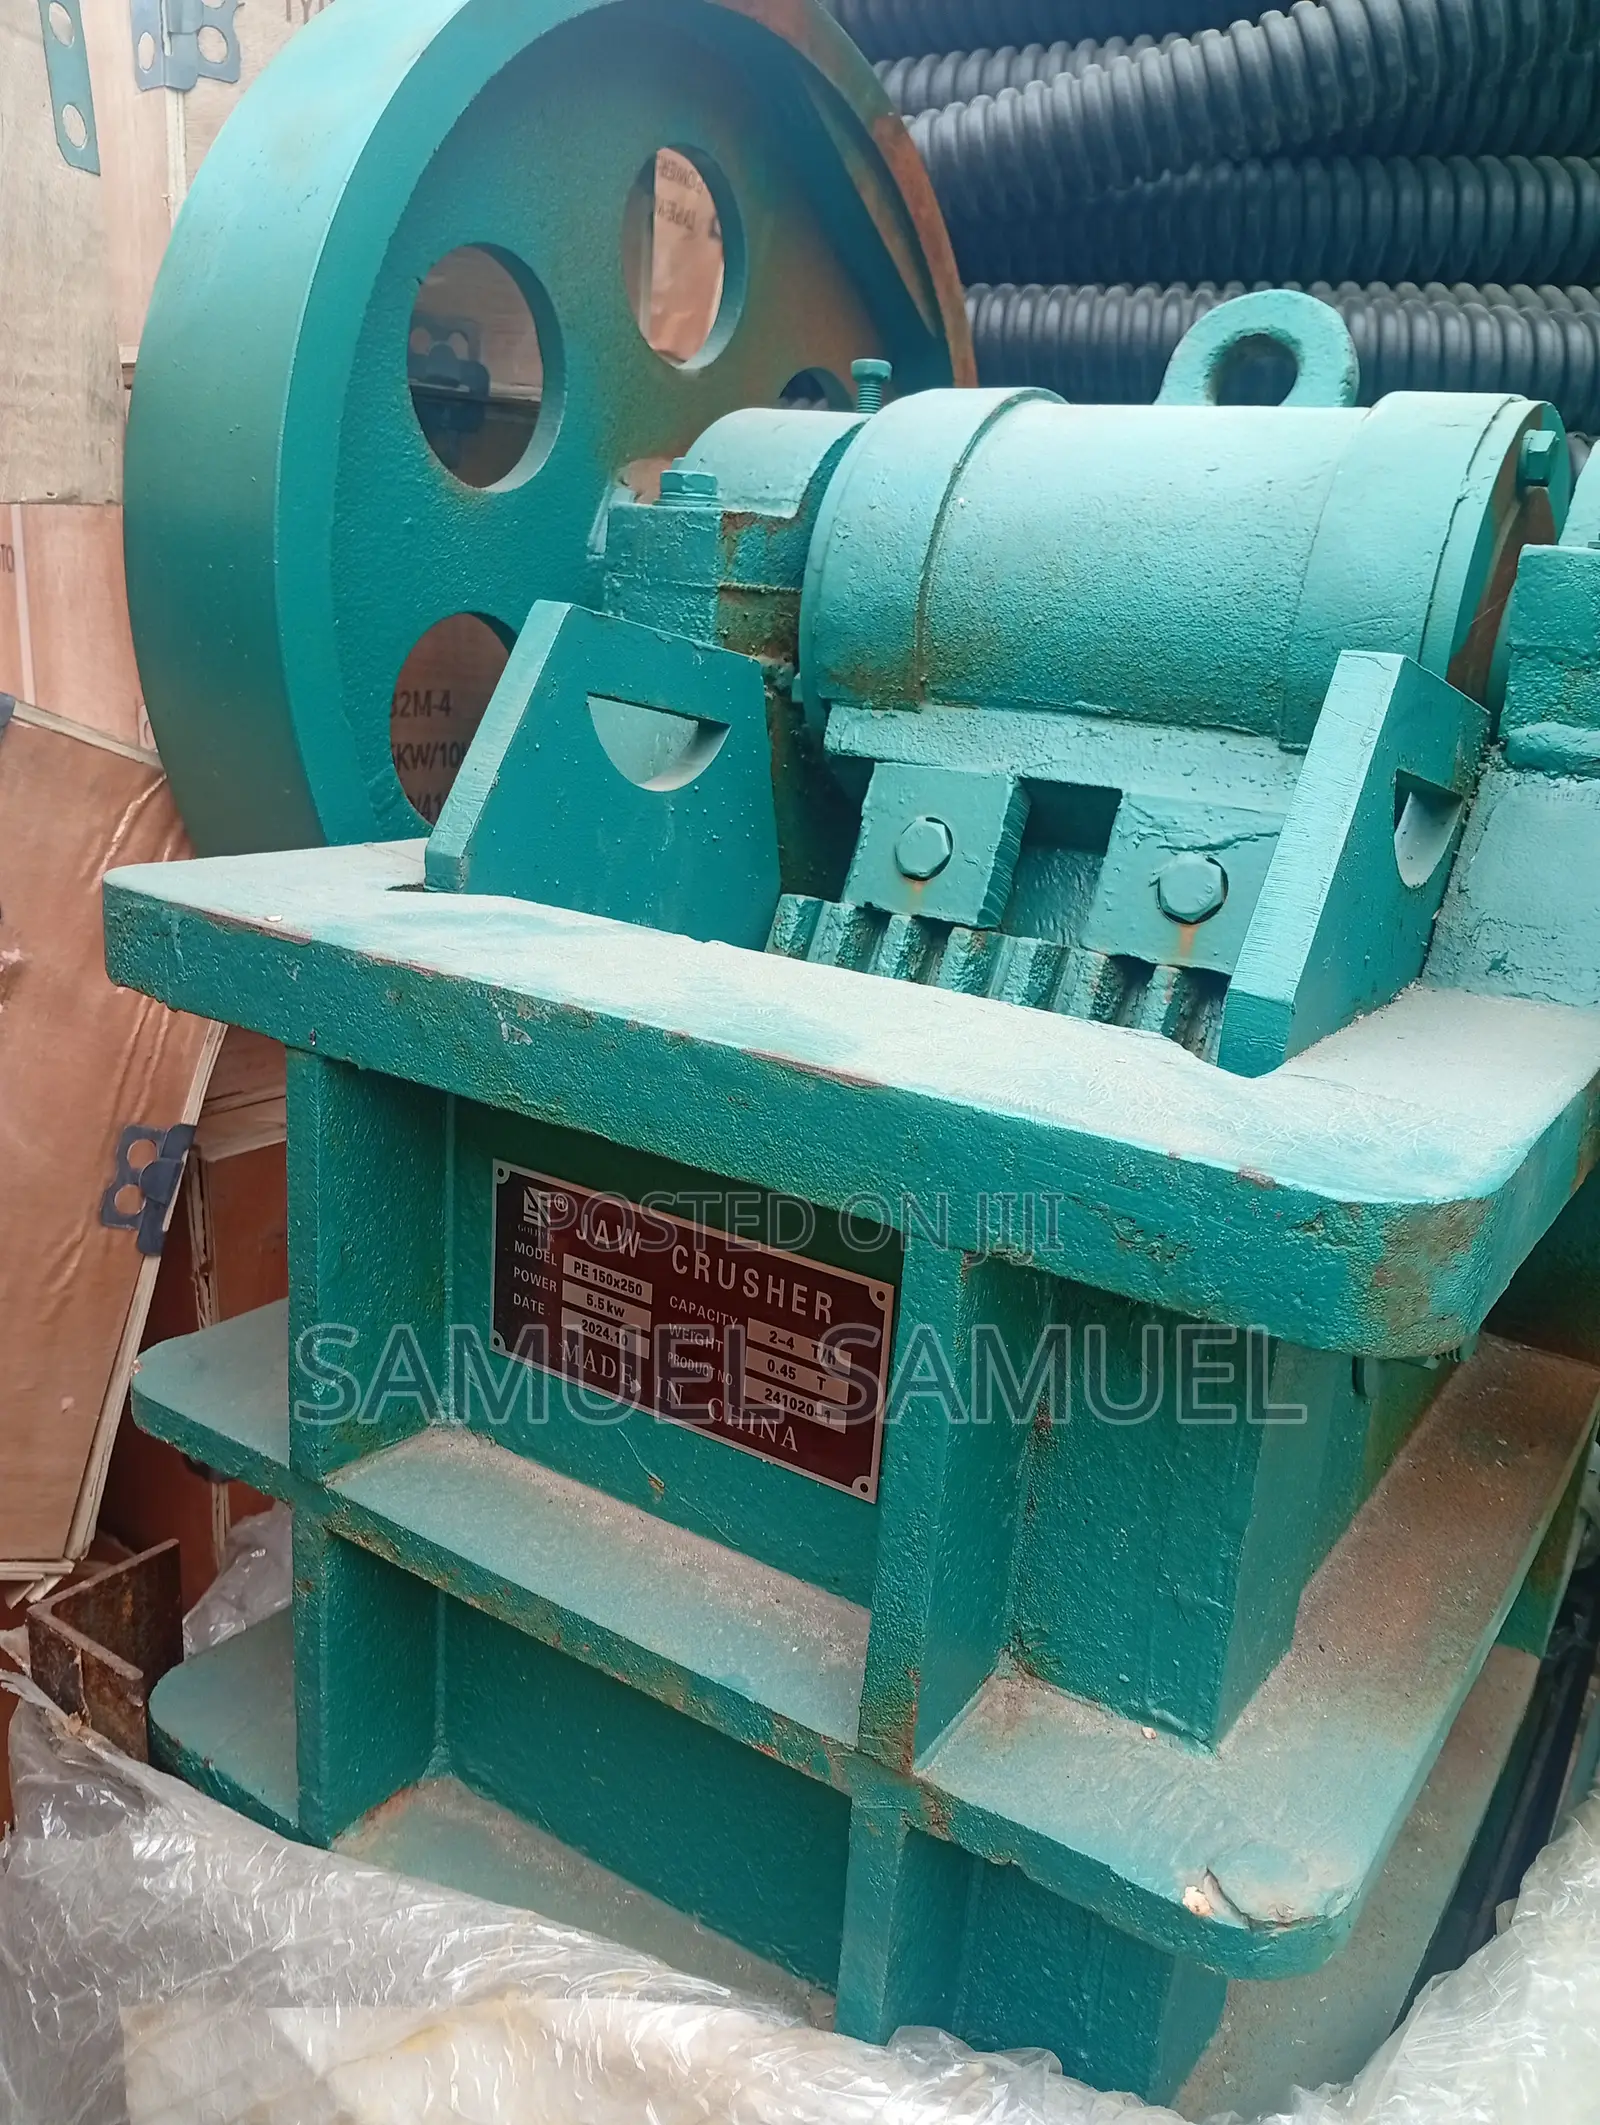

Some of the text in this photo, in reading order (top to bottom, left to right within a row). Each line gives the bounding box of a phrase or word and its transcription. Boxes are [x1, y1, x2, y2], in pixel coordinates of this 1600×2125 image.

[513, 1267, 557, 1293] POWER
[514, 1240, 643, 1297] MODEL PE 150x250
[576, 1214, 833, 1324] JAW CRUSHER
[513, 1293, 629, 1347] DATE 2024.10
[669, 1295, 738, 1329] CAPACITY
[668, 1323, 724, 1353] WEIGHT
[668, 1351, 715, 1379] PRODUCT
[767, 1358, 826, 1391] 0.45 T
[561, 1340, 798, 1452] MADE IN CHINA
[764, 1387, 831, 1423] 241020-1
